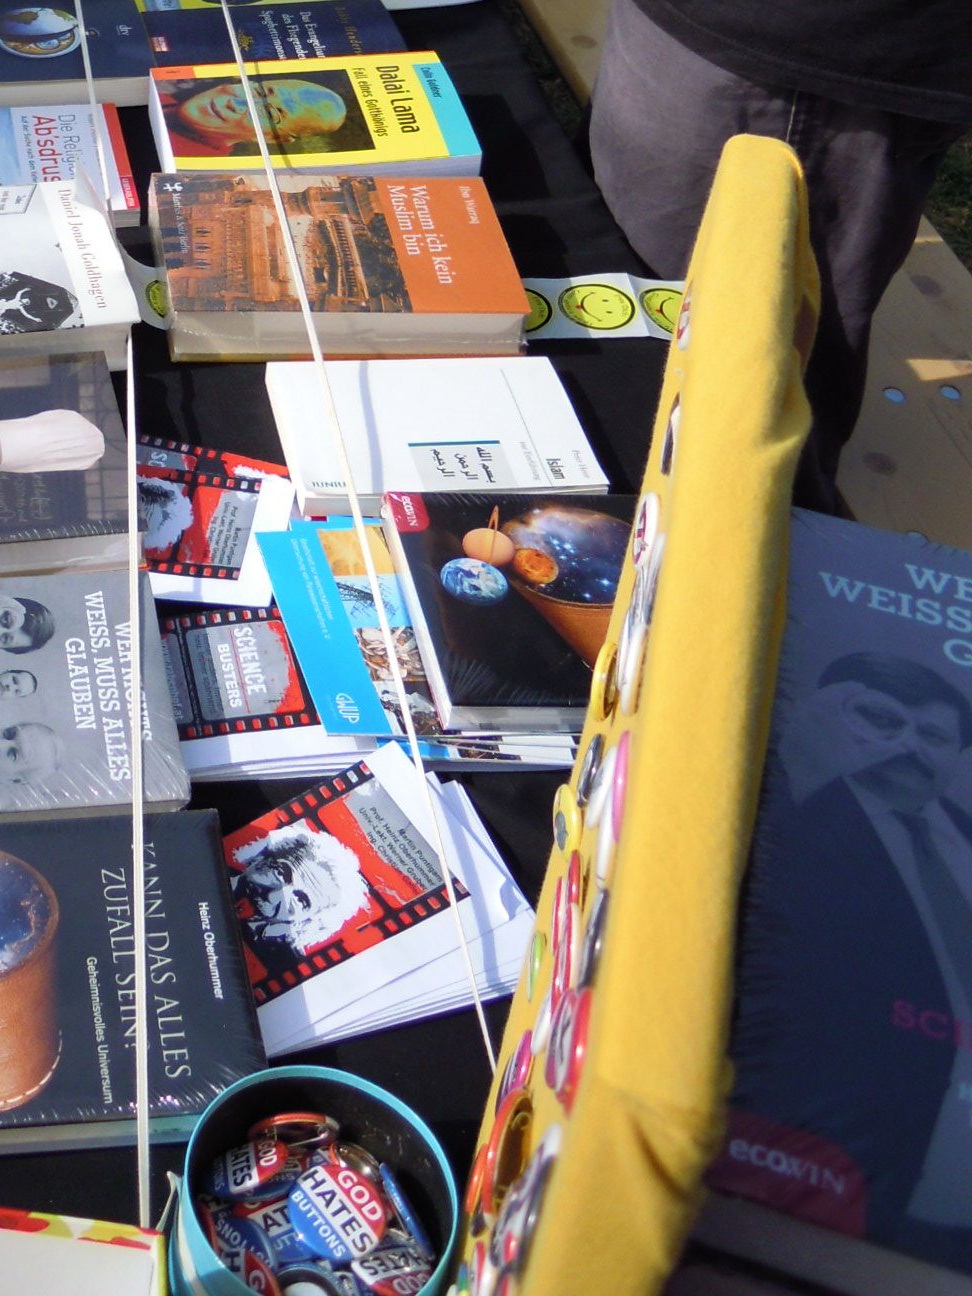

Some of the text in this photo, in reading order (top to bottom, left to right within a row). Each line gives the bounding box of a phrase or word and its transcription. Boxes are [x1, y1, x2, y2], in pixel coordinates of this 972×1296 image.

[352, 67, 371, 80] Fall
[358, 80, 375, 97] eines
[376, 65, 421, 134] Dalai Lama
[58, 115, 76, 132] Die
[387, 185, 424, 255] Muslim bin
[459, 186, 471, 198] Ibn
[57, 188, 108, 309] Daniel Jonah Goldhagen
[410, 185, 456, 284] Warum ich kein
[546, 458, 565, 479] Islam
[65, 637, 96, 730] GLAUBEN
[84, 591, 131, 781] WEISS, MUSS ALLES
[218, 644, 242, 708] BUSTERS
[233, 627, 266, 695] SCIENCE
[336, 693, 360, 724] GWUP
[101, 868, 136, 963] ZUFALL
[131, 842, 191, 1079] KANN DAS ALLES
[198, 902, 224, 999] Heinz Oberhummer
[86, 957, 114, 1104] Geheimnisvolles Universum
[258, 1140, 278, 1167] GOD
[290, 1188, 348, 1258] BUTTONS
[300, 1166, 373, 1254] HATES
[337, 1170, 383, 1221] GOD
